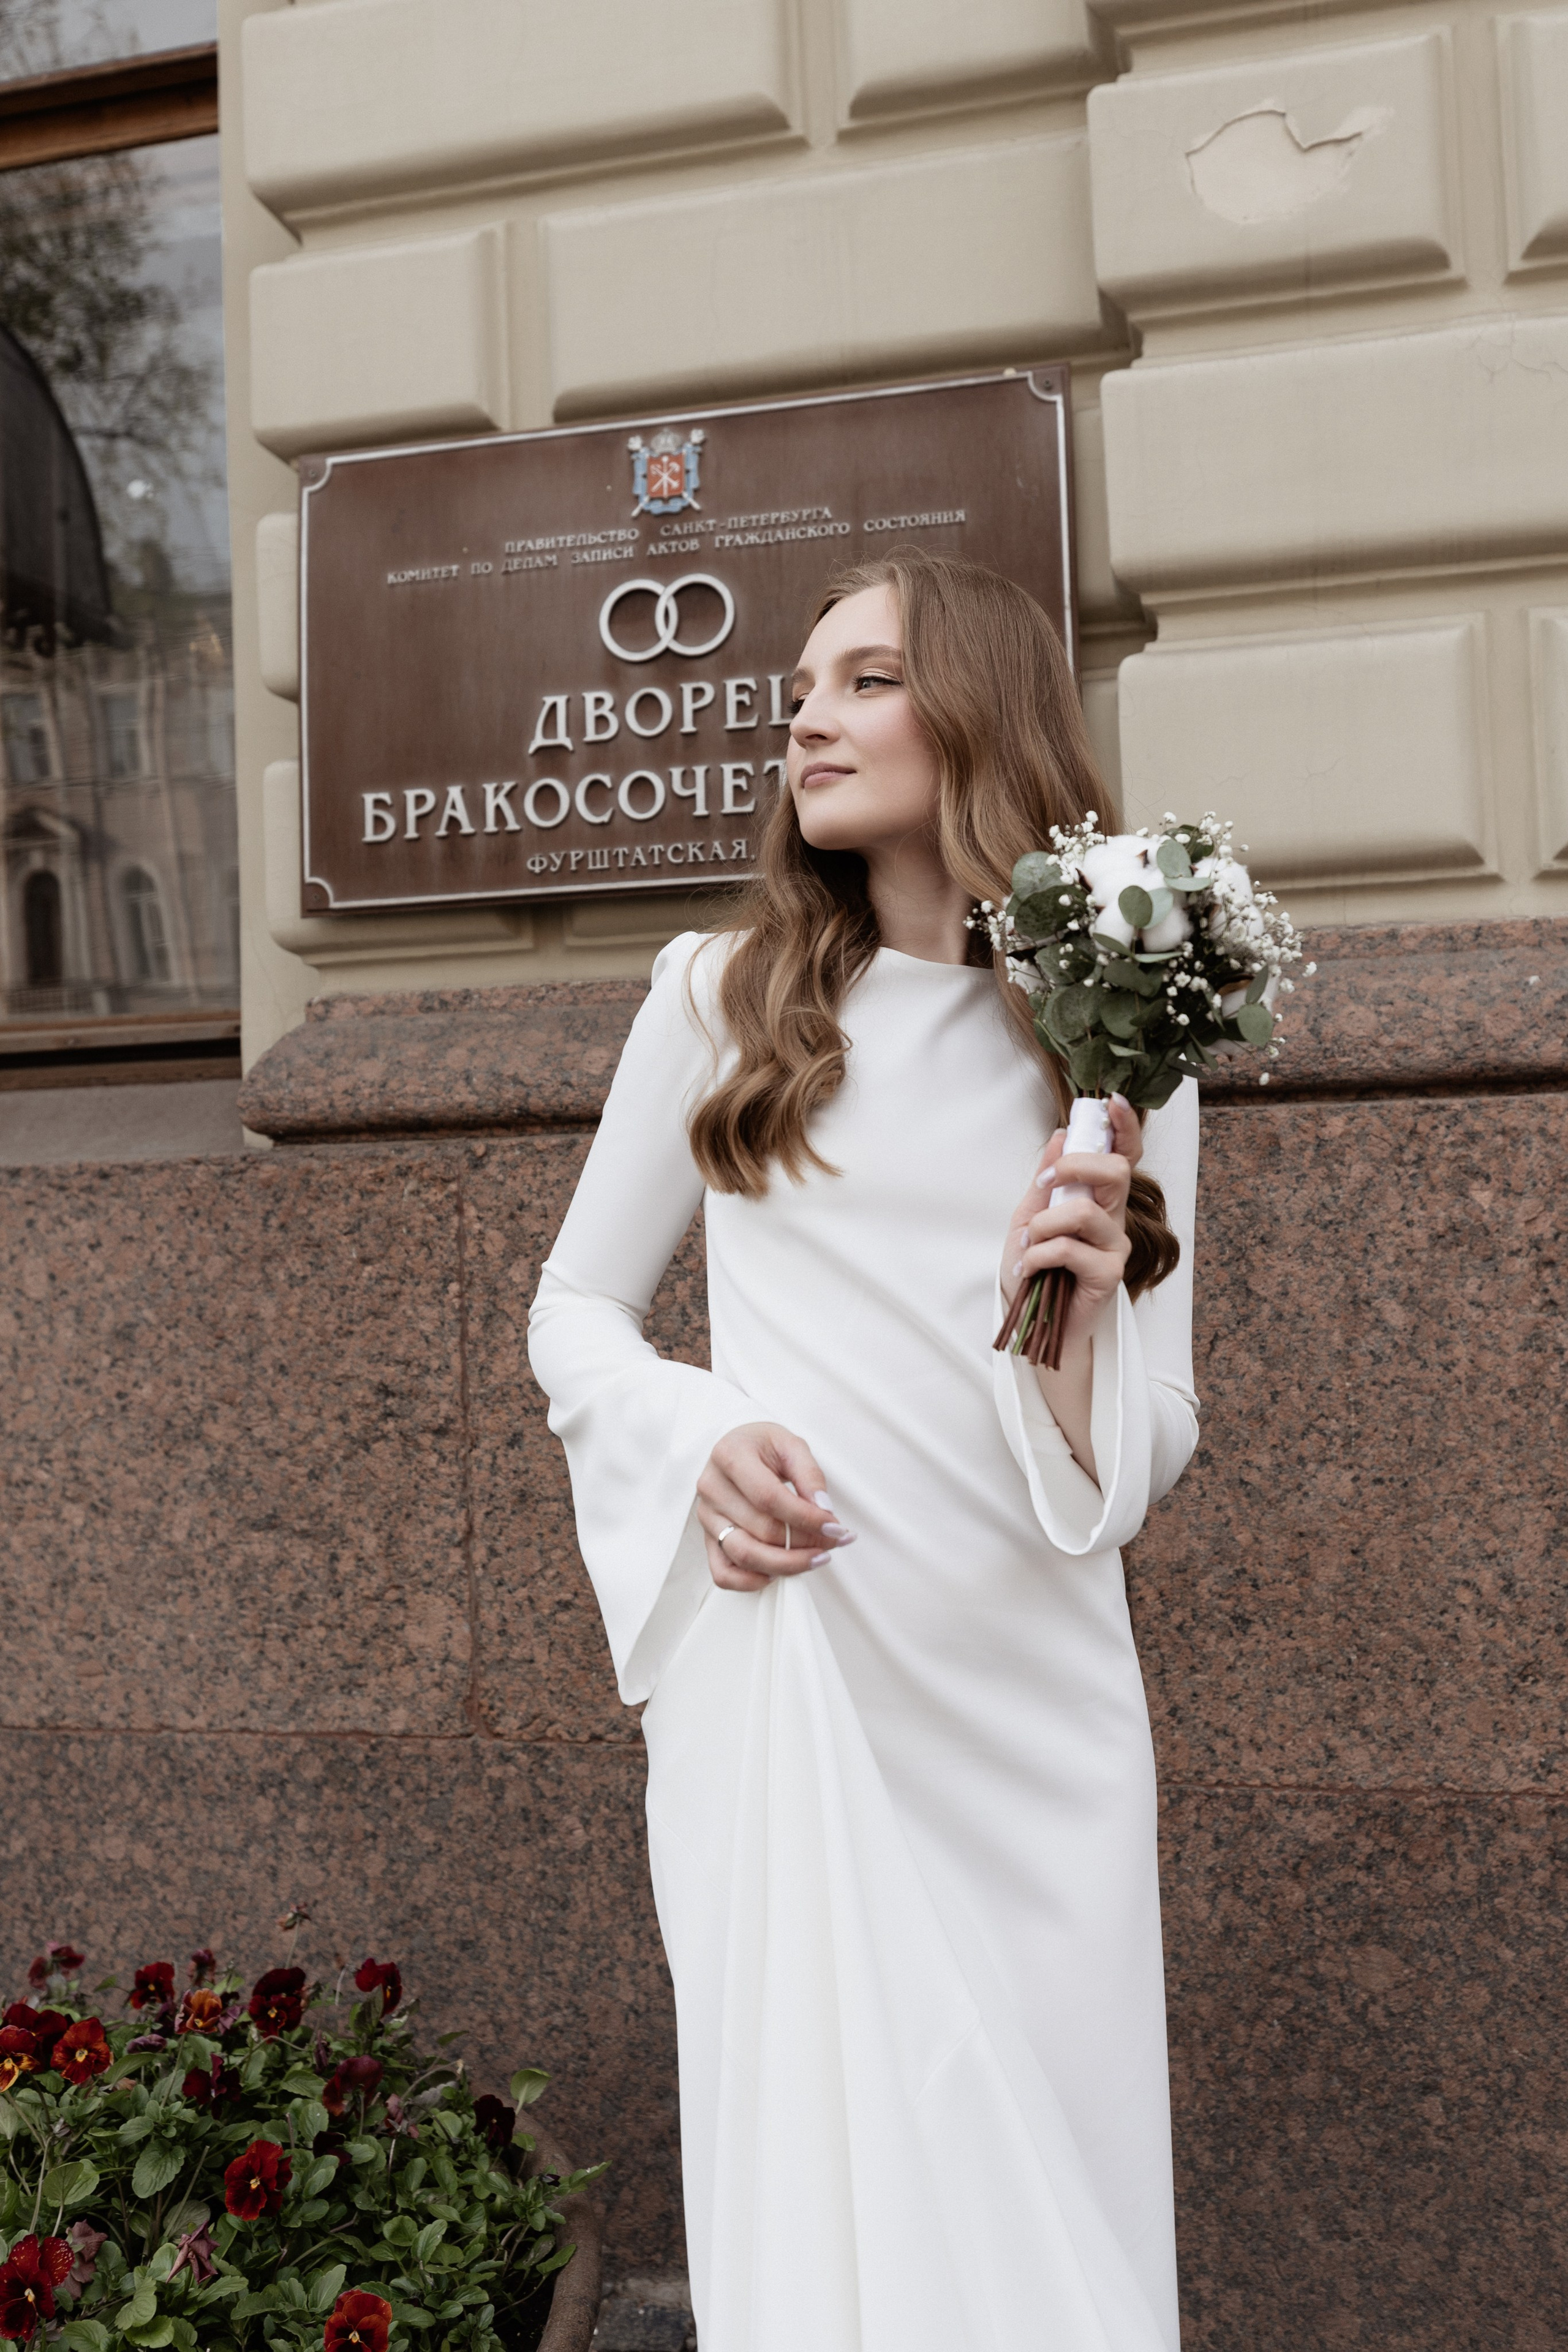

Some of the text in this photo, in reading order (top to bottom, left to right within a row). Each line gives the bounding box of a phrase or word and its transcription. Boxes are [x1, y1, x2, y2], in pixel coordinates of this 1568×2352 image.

[386, 510, 967, 584] КОМИТЕТ ПО ДЕЛАМ ЗАПИСИ АКТОВ ГРАЖДАНСКОГО СОСТОЯНИЯ
[505, 507, 832, 553] ПРАВИТЕЛЬСТВО САНКТ-ПЕТЕРБУРГА
